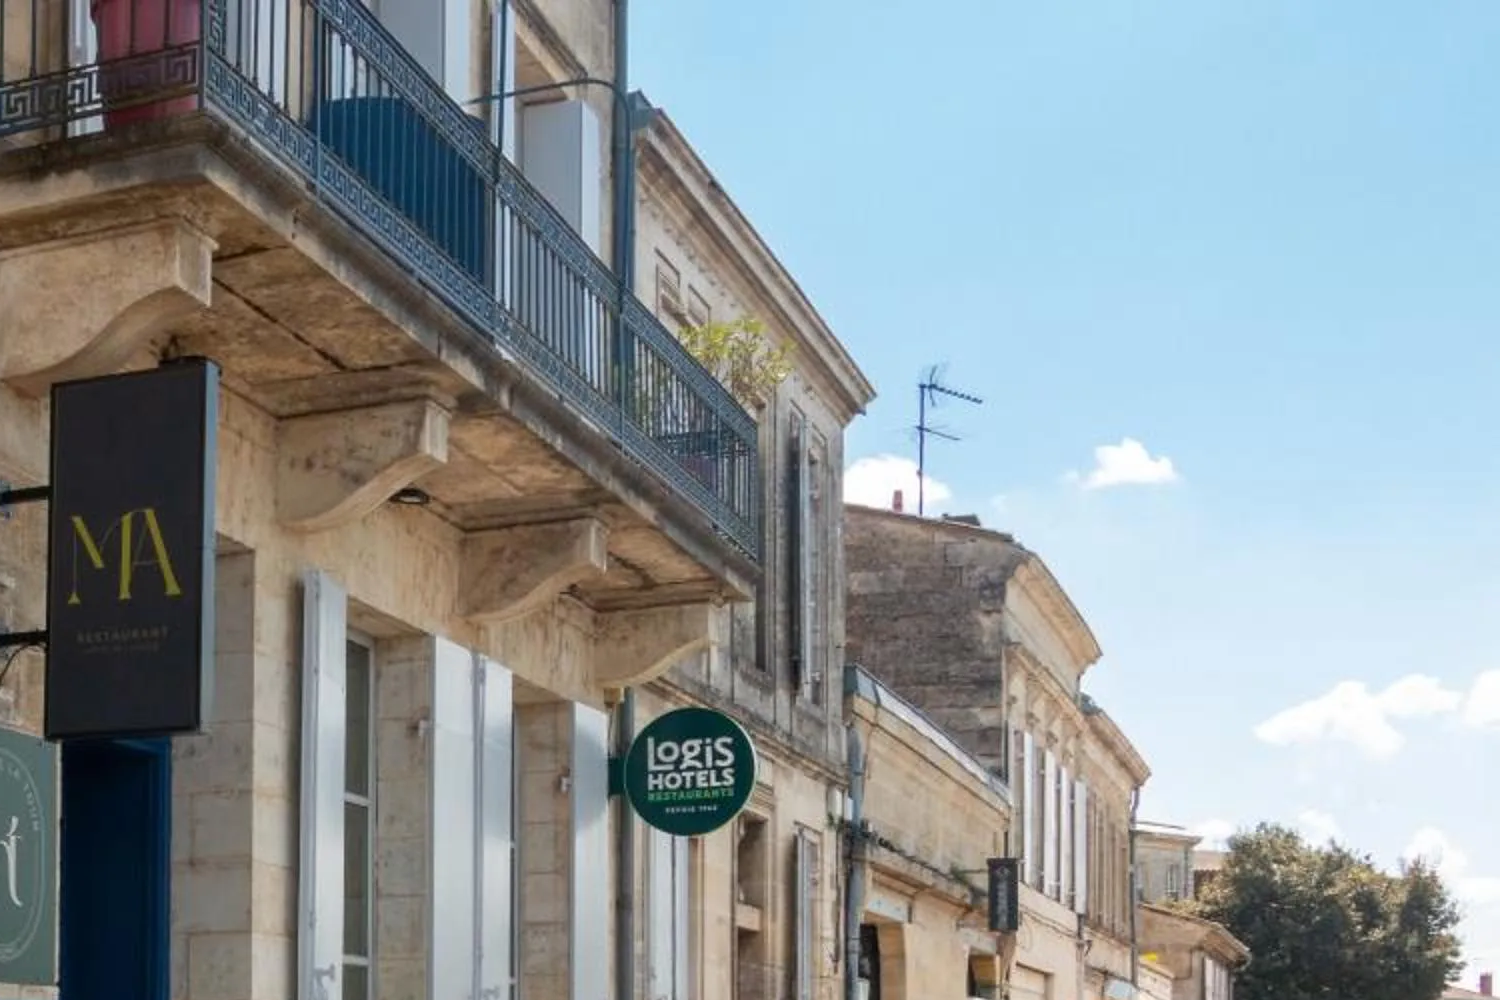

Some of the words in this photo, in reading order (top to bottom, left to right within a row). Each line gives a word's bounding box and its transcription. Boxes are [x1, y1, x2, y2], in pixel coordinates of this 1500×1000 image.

[67, 508, 183, 605] MA
[77, 625, 169, 643] RESTAURANT
[647, 768, 735, 791] HOTELS
[647, 788, 735, 801] RESTAURANTS
